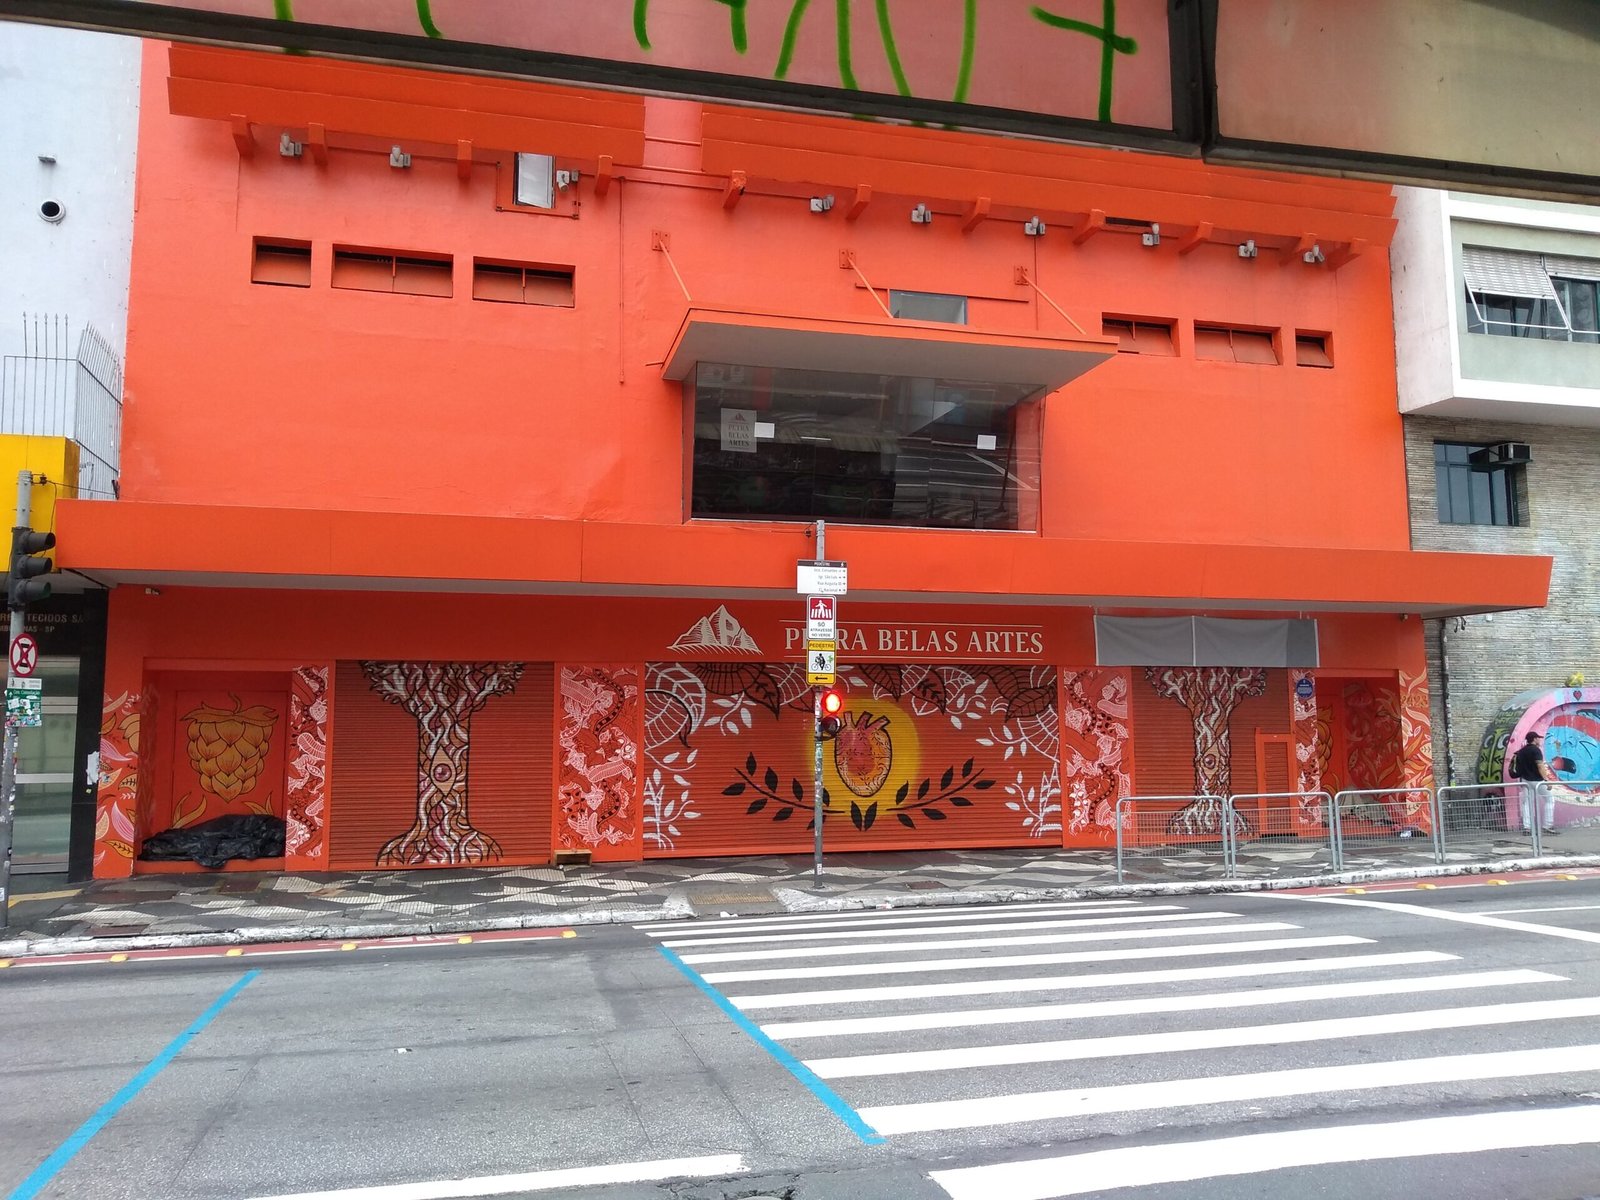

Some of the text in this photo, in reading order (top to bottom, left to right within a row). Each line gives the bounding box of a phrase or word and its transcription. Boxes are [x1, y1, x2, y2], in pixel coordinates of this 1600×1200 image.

[728, 439, 750, 447] ARTES
[27, 613, 68, 623] TECIDOS
[784, 627, 1043, 654] PRA BELAS ARTES
